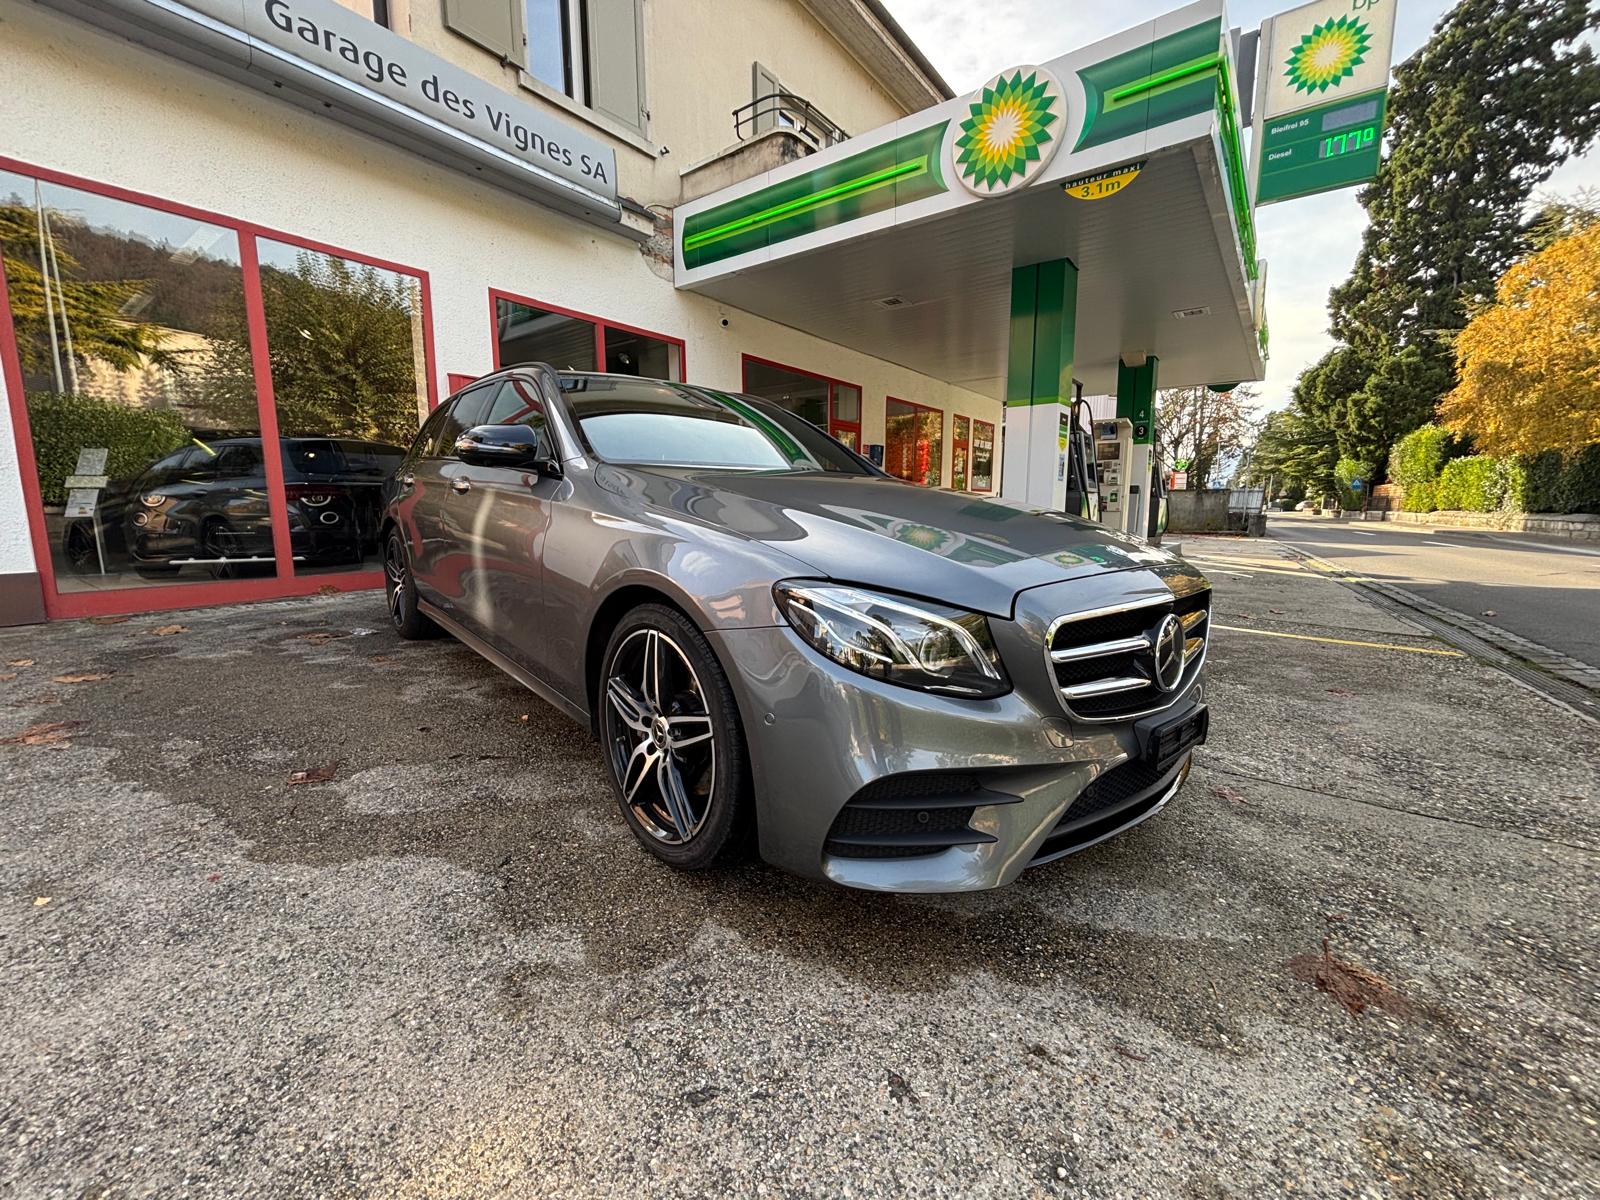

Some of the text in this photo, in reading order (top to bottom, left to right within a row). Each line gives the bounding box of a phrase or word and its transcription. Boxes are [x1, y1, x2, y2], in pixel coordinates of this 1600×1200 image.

[264, 0, 608, 184] Garage des Vignes SA
[1271, 118, 1310, 135] Bleifrei 95
[1268, 148, 1293, 161] Diesel
[1065, 162, 1140, 189] hauteur maxi
[1080, 180, 1121, 198] 3.1m
[1139, 409, 1145, 419] 4
[1138, 426, 1145, 435] 3
